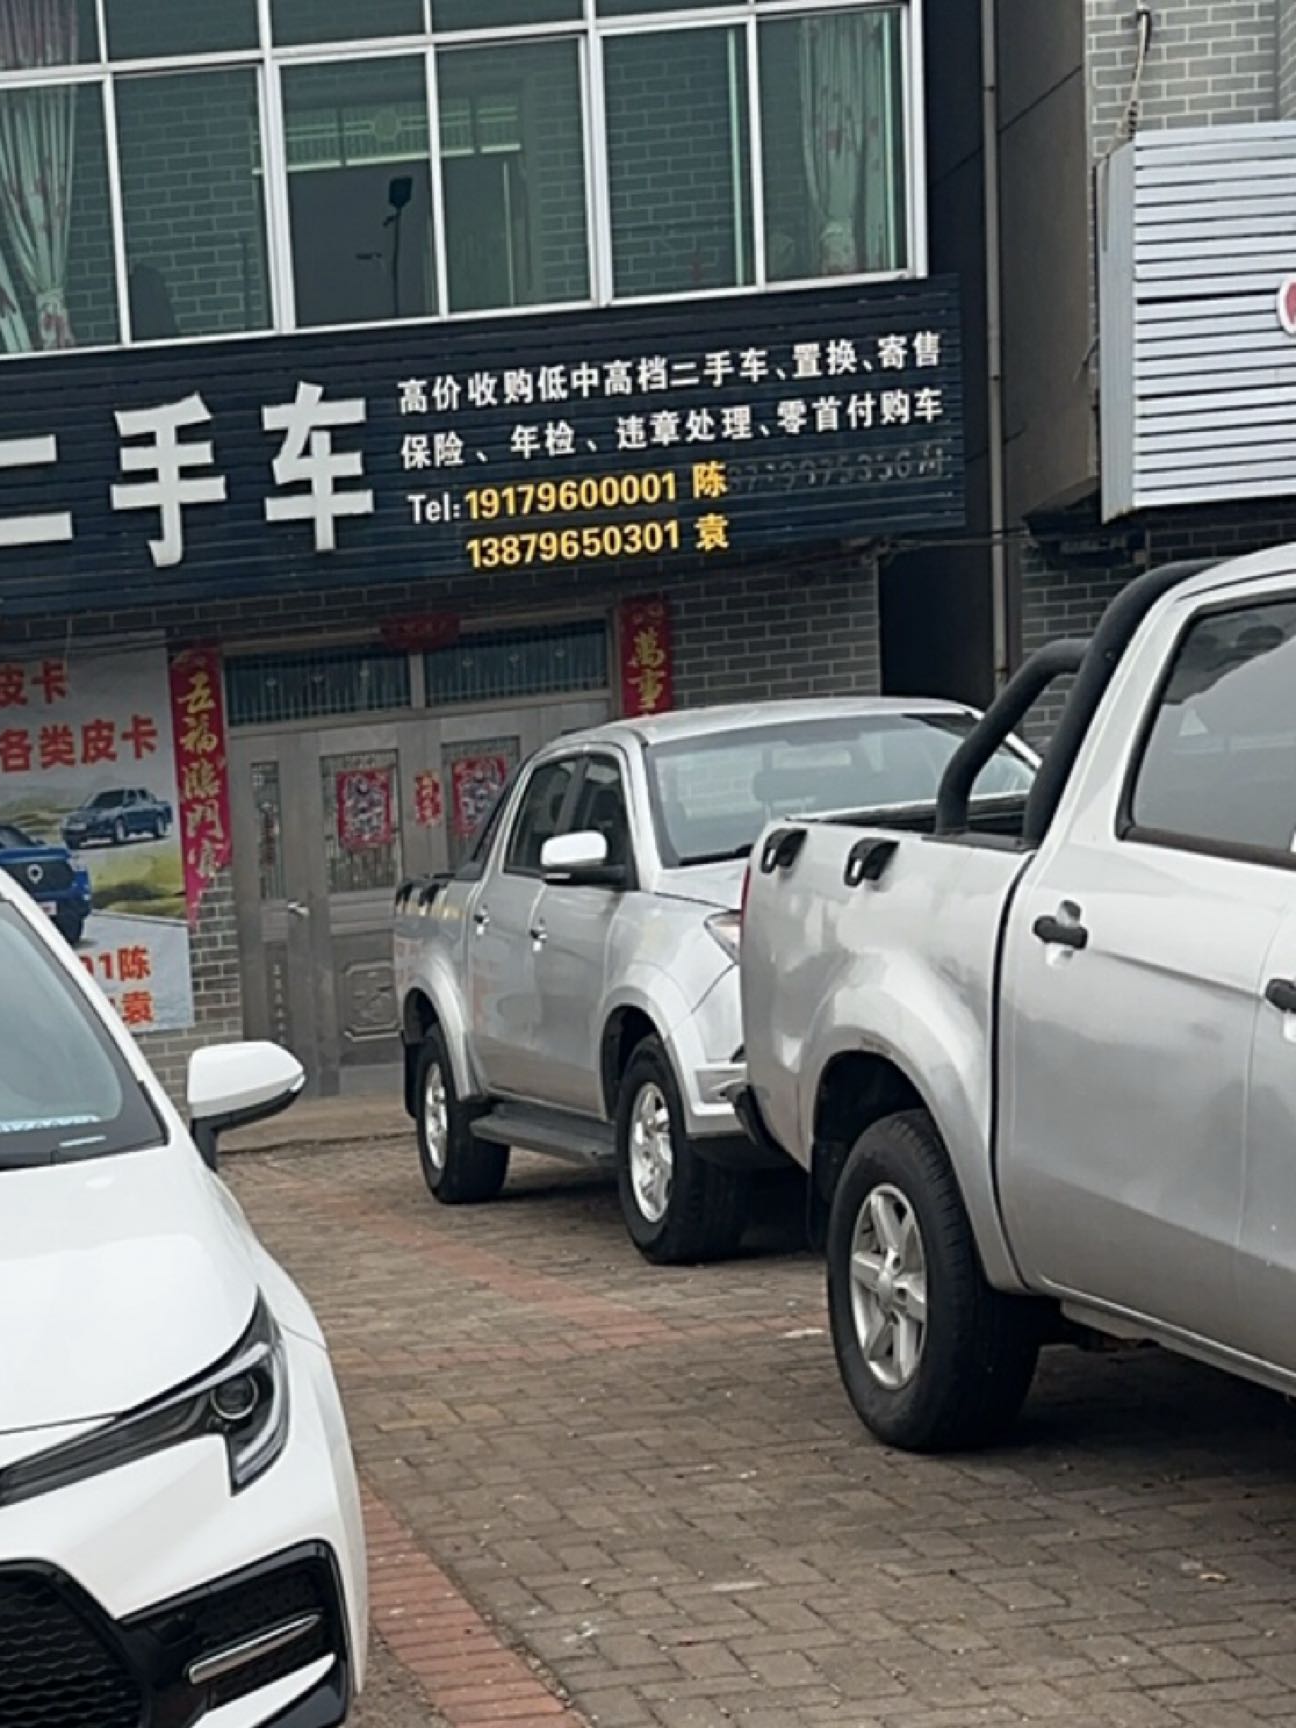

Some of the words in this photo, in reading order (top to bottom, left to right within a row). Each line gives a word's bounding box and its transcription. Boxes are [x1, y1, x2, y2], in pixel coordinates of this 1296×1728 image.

[397, 330, 941, 415] 高价收购低中高档二手车、置换、寄售
[692, 460, 729, 498] 陈
[465, 519, 681, 569] 13879650301
[695, 512, 730, 550] 袁
